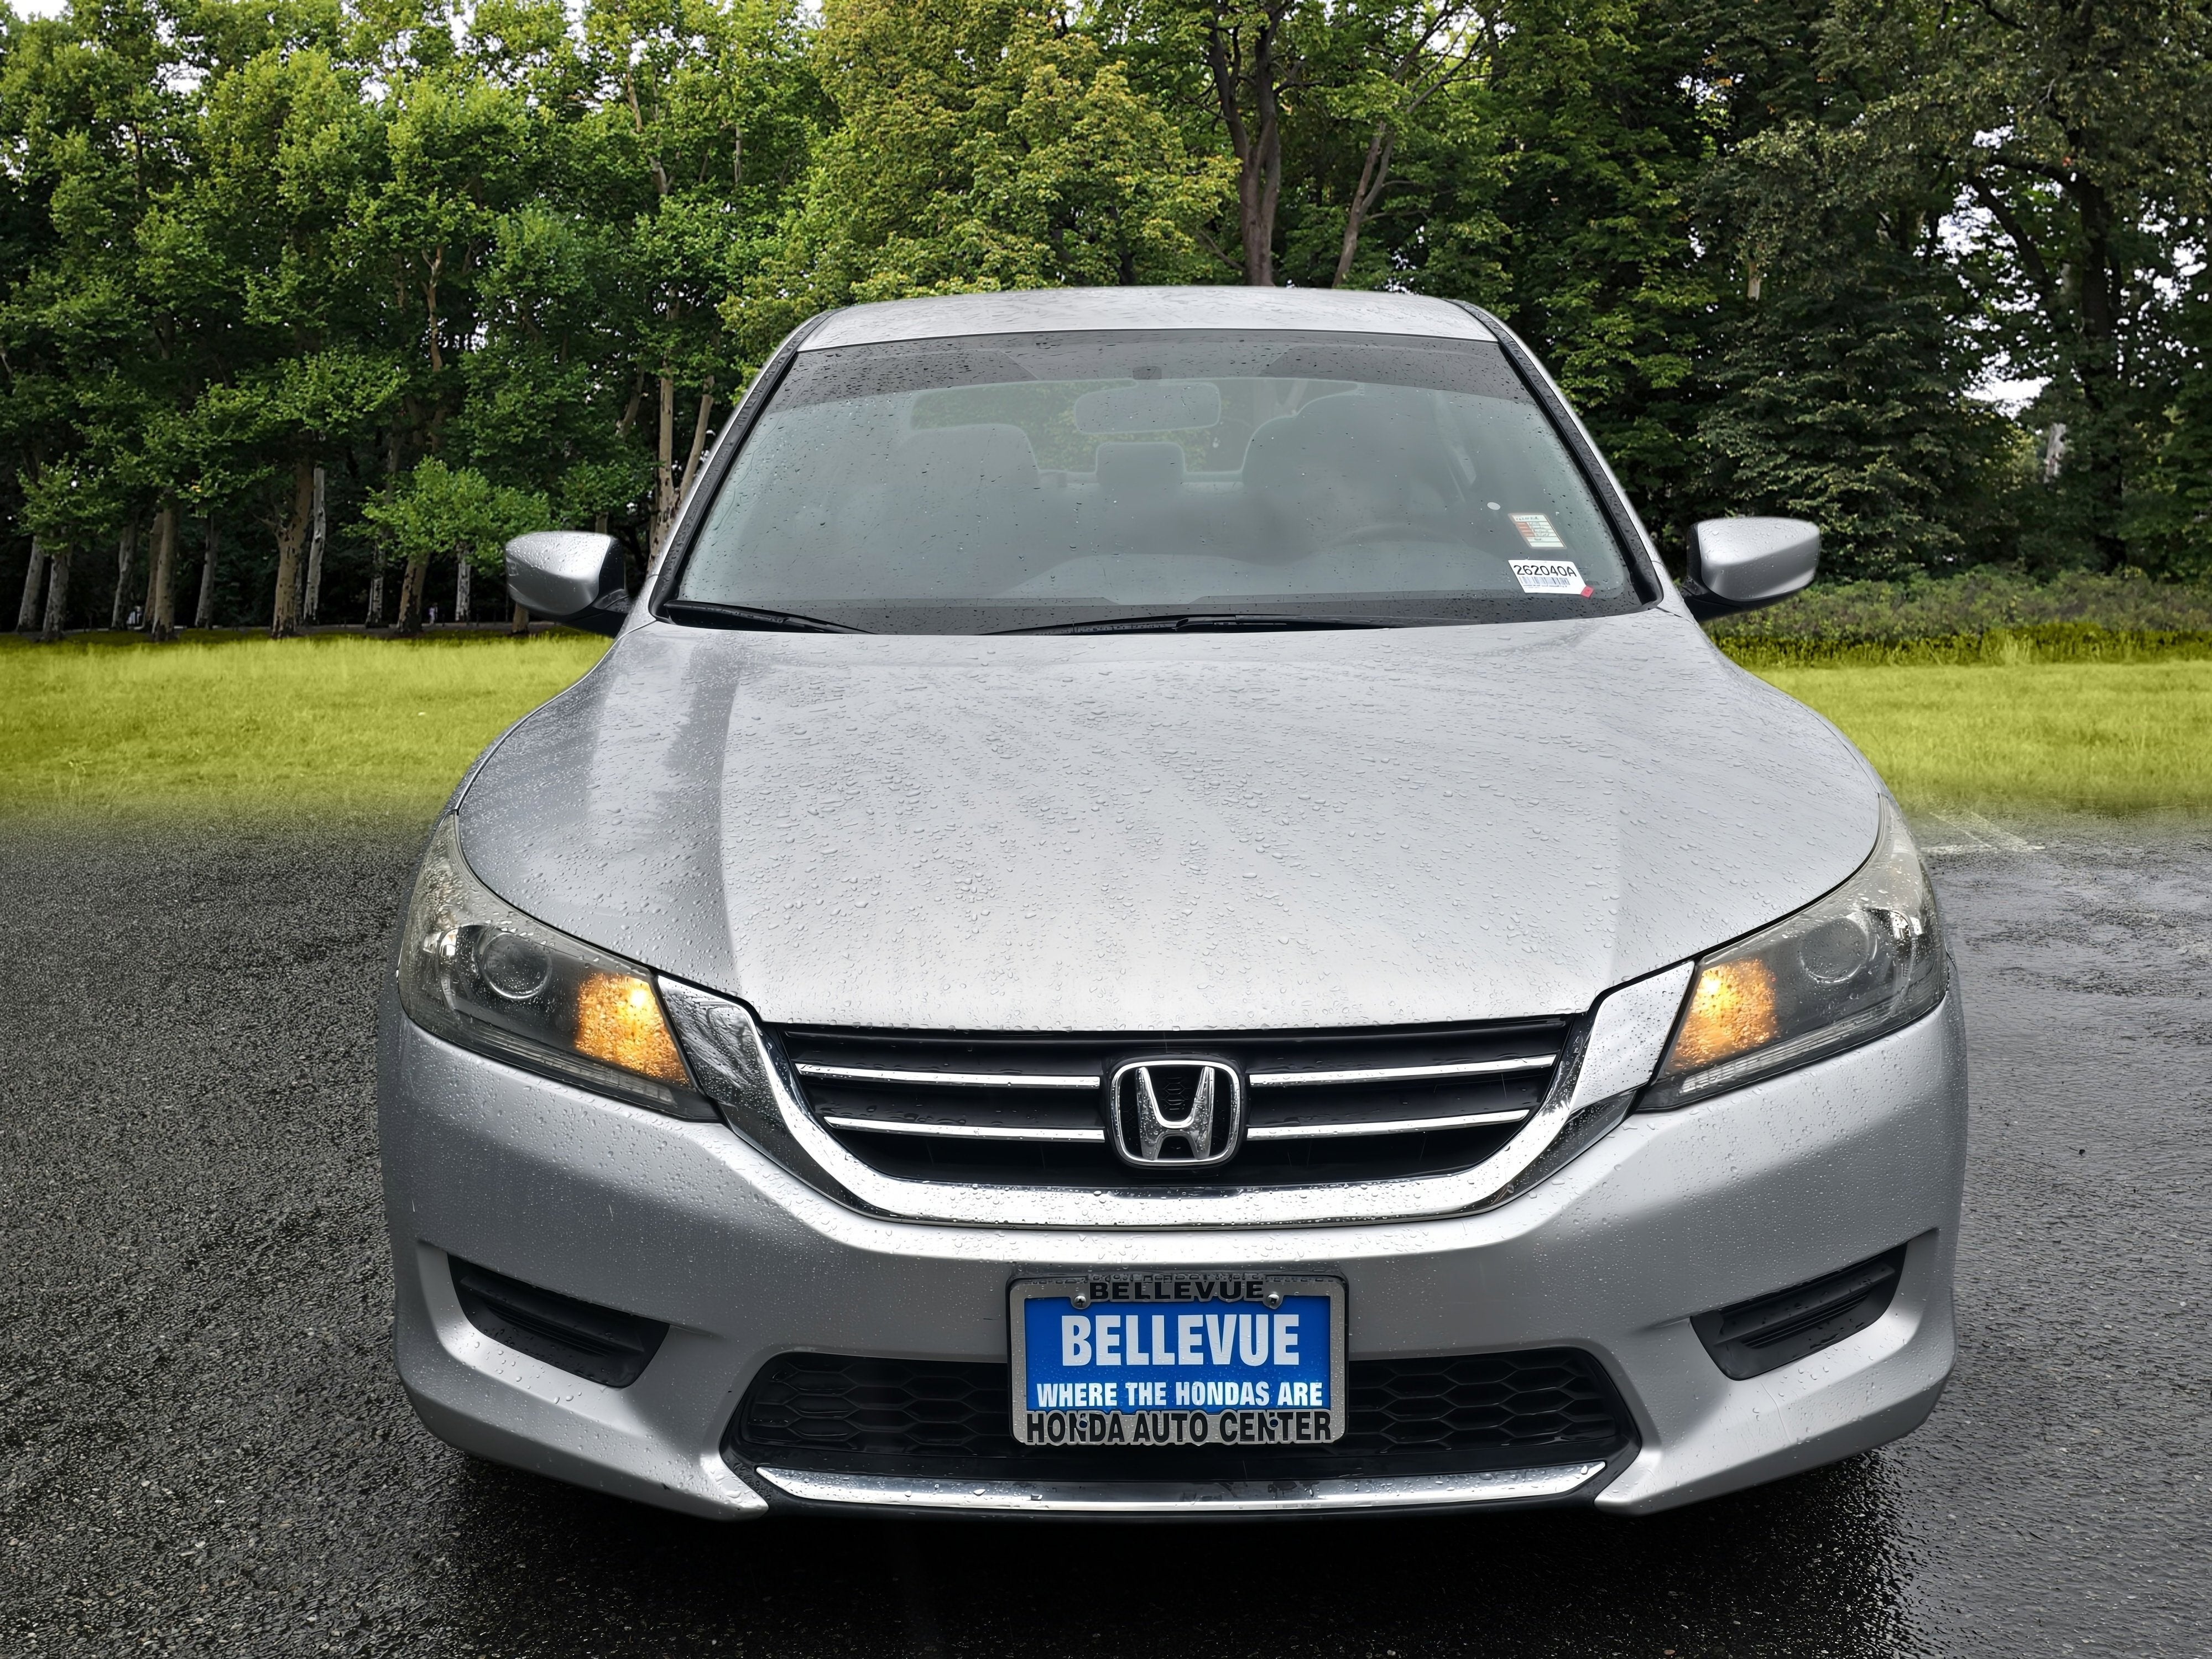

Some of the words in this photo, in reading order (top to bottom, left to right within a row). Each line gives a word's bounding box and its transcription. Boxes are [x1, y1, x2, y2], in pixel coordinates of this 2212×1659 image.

[1514, 565, 1577, 577] 262040A
[1089, 1281, 1264, 1300] BELLEVUE
[1062, 1314, 1300, 1366] BELLEVUE
[1036, 1383, 1117, 1407] WHERE
[1125, 1382, 1166, 1406] THE
[1176, 1381, 1270, 1406] HONDAS
[1277, 1382, 1323, 1406] ARE
[1027, 1412, 1125, 1443] HONDA
[1133, 1412, 1208, 1442] AUTO
[1219, 1411, 1331, 1442] CENTER
